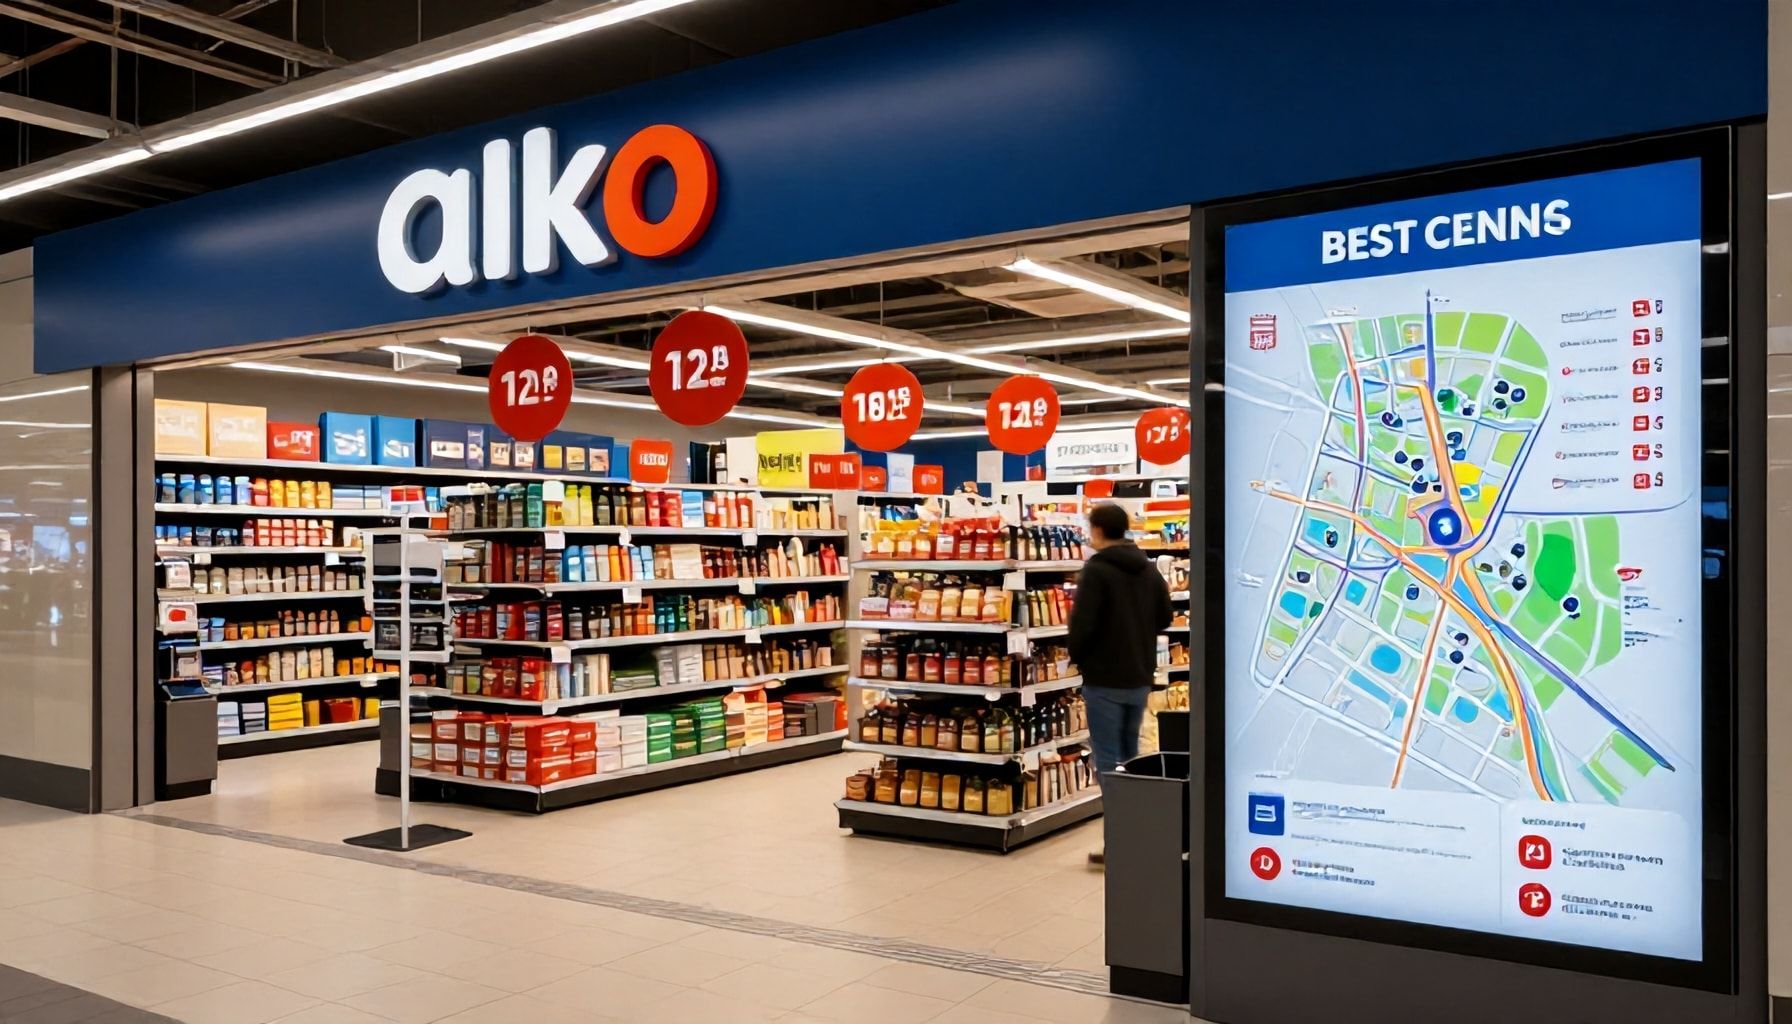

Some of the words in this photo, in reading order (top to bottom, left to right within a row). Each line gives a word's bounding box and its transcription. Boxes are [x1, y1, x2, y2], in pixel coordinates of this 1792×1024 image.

[377, 123, 718, 294] alko
[1321, 219, 1418, 265] BEST
[1424, 198, 1572, 250] CENNS
